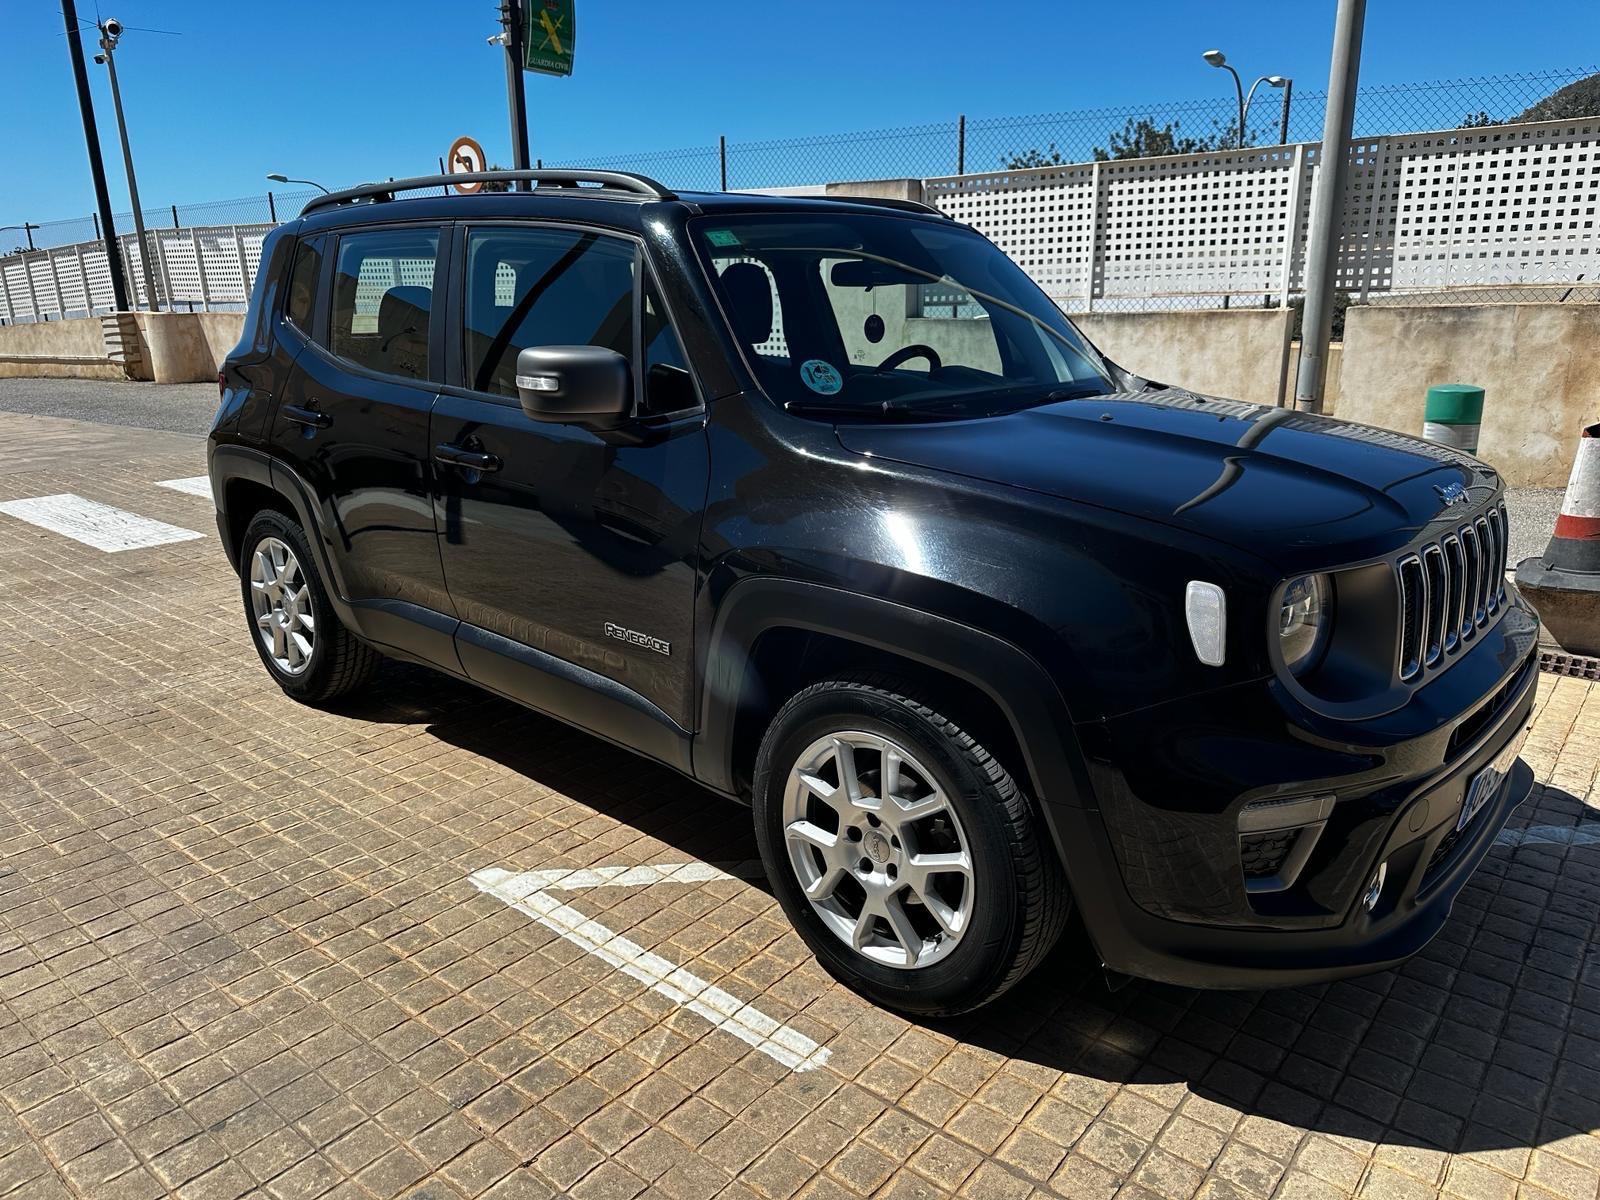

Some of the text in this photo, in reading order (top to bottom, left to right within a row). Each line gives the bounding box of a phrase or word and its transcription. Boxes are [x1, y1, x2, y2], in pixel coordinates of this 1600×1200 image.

[528, 57, 569, 71] GUARDIA CIVIL
[604, 621, 671, 656] RENEGADE
